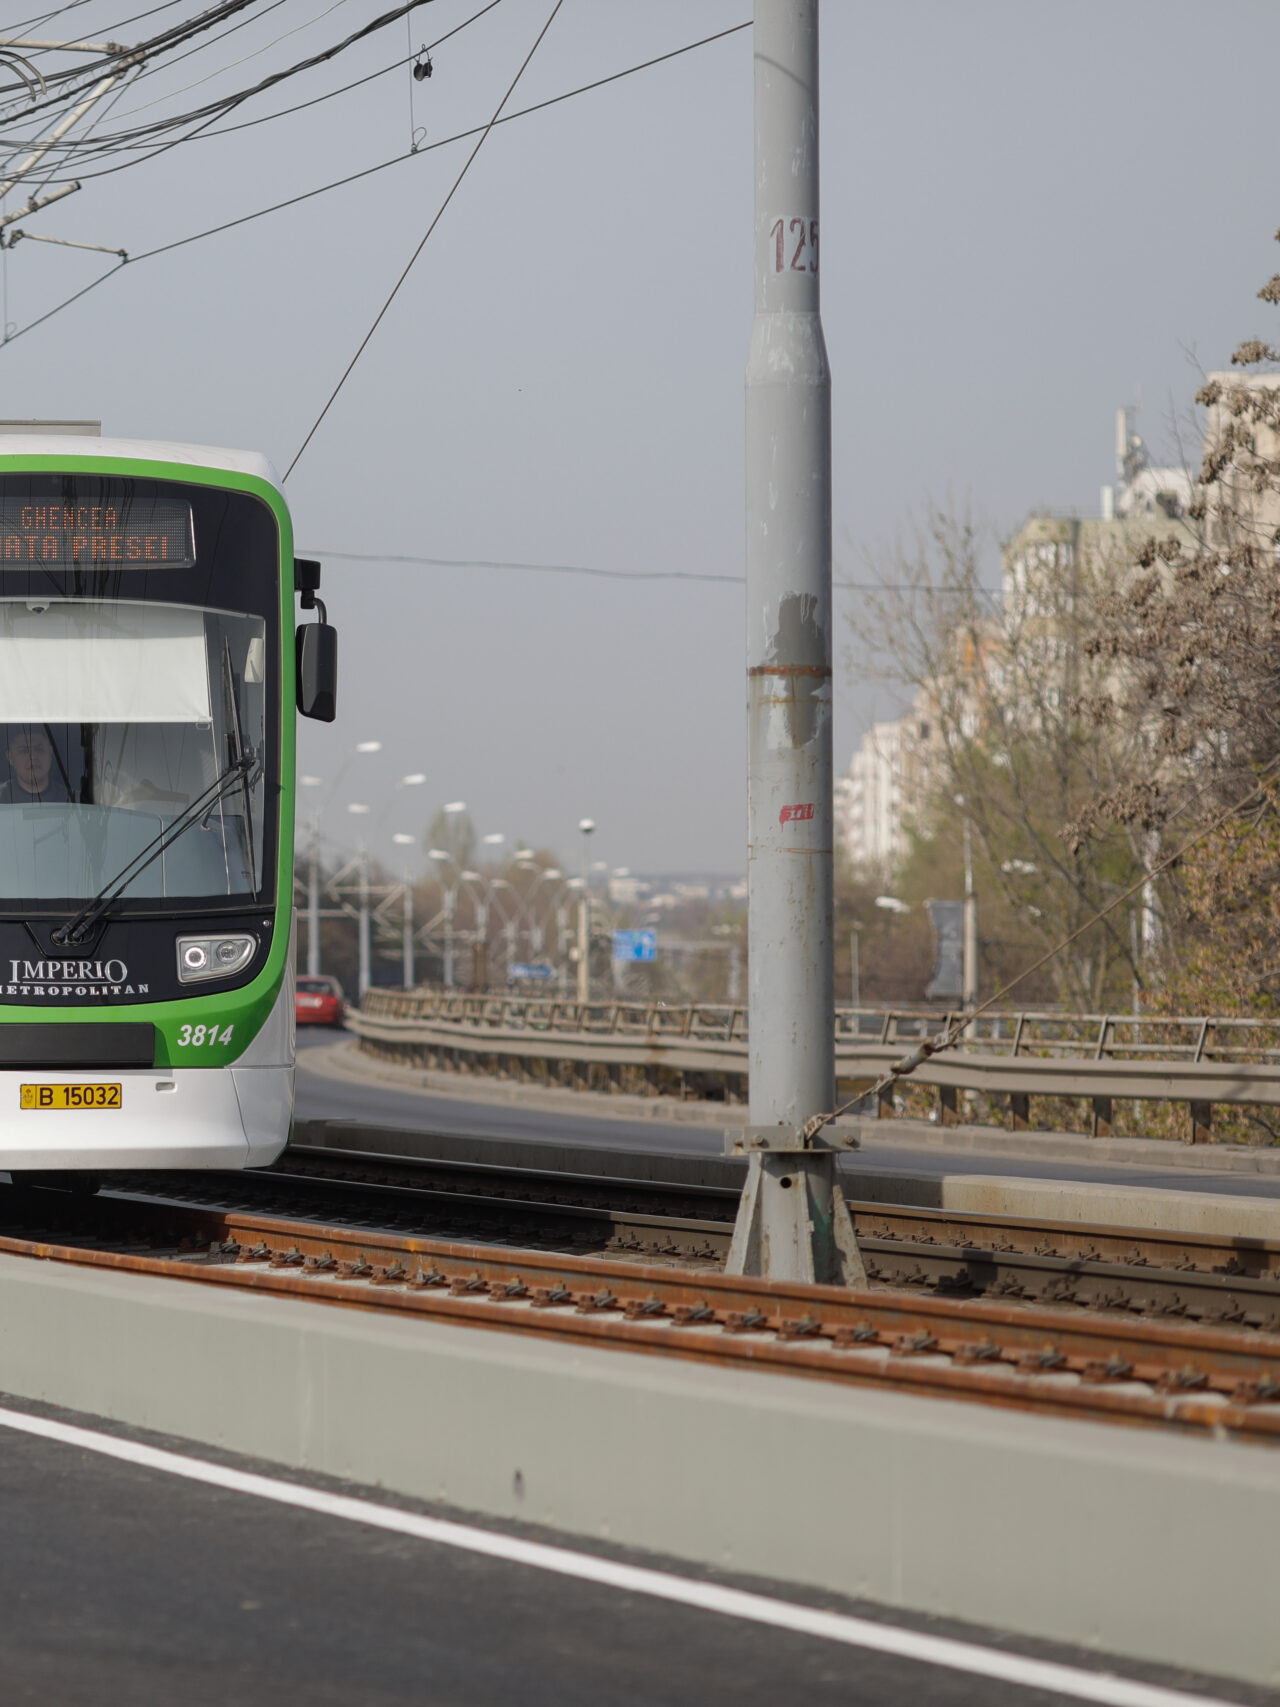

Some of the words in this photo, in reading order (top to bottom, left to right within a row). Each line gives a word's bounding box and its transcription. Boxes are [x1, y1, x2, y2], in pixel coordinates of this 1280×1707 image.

[21, 506, 117, 530] GHENCEA
[73, 536, 168, 559] PRESEI
[9, 959, 128, 984] IMPERIO
[177, 1024, 234, 1046] 3814
[39, 1087, 54, 1106] B
[63, 1086, 119, 1106] 15032
